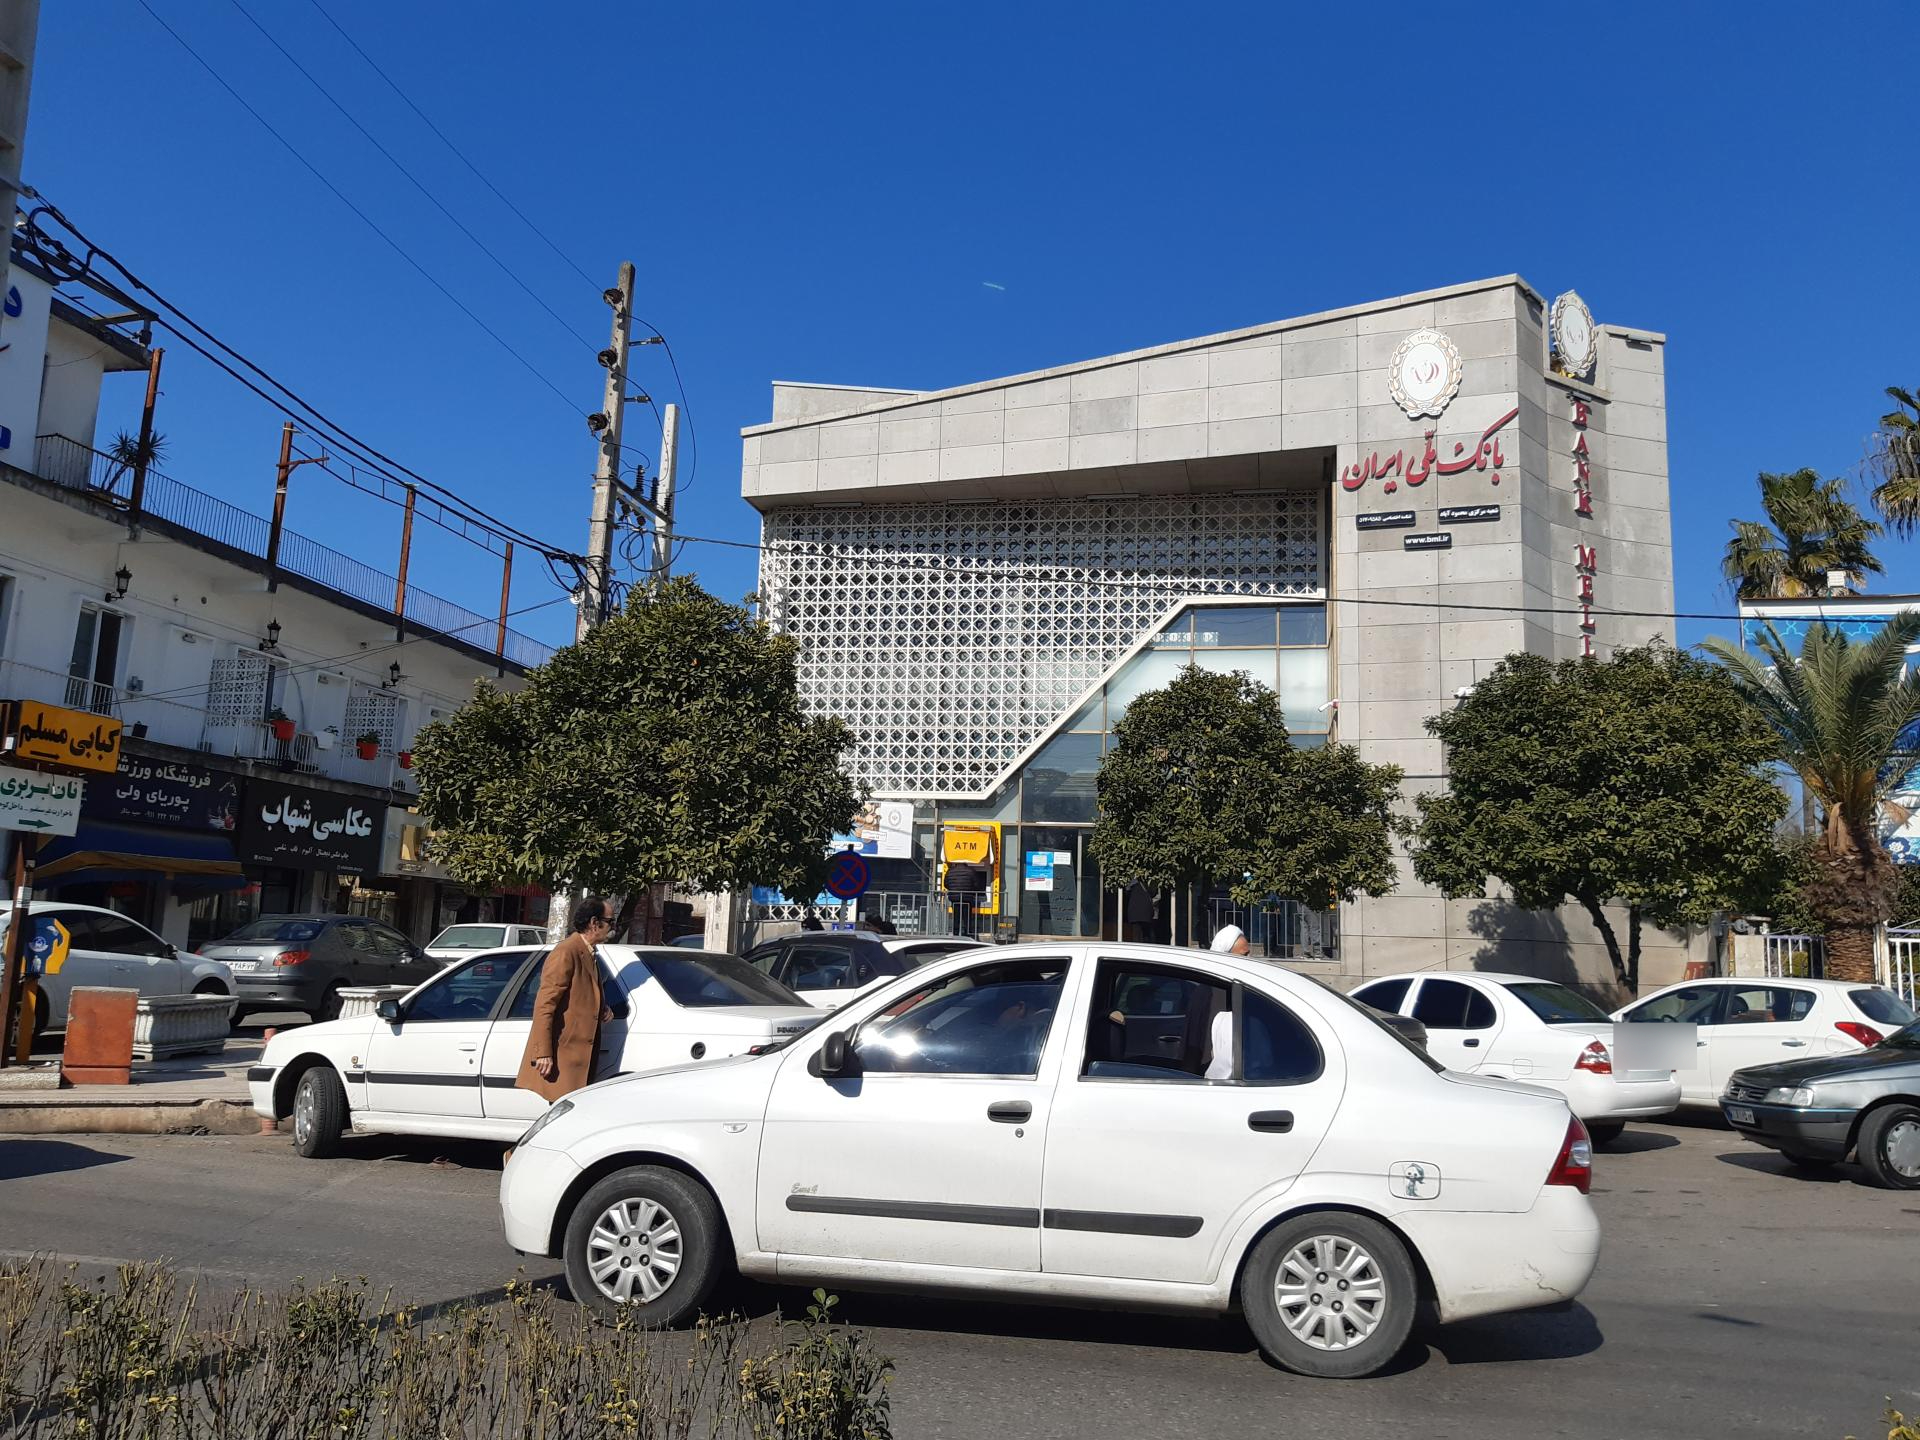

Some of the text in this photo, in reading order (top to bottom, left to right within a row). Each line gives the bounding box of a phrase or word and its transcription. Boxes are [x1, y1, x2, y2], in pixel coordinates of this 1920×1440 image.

[1436, 407, 1519, 487] بانک
[1571, 400, 1593, 515] BANK
[1341, 449, 1403, 494] ایران
[1450, 510, 1468, 518] محمود
[1405, 535, 1449, 545] www.bml.ir
[1573, 544, 1596, 657] MELL
[18, 711, 121, 761] کبابی مسلم
[117, 755, 211, 789] فروشگاه ورزش
[0, 777, 51, 800] بربری
[51, 780, 78, 800] نان
[116, 784, 190, 813] پوریای ولی
[261, 795, 373, 841] عکاسی شهاب
[954, 842, 977, 851] ATM
[776, 1025, 806, 1035] PEUGEO
